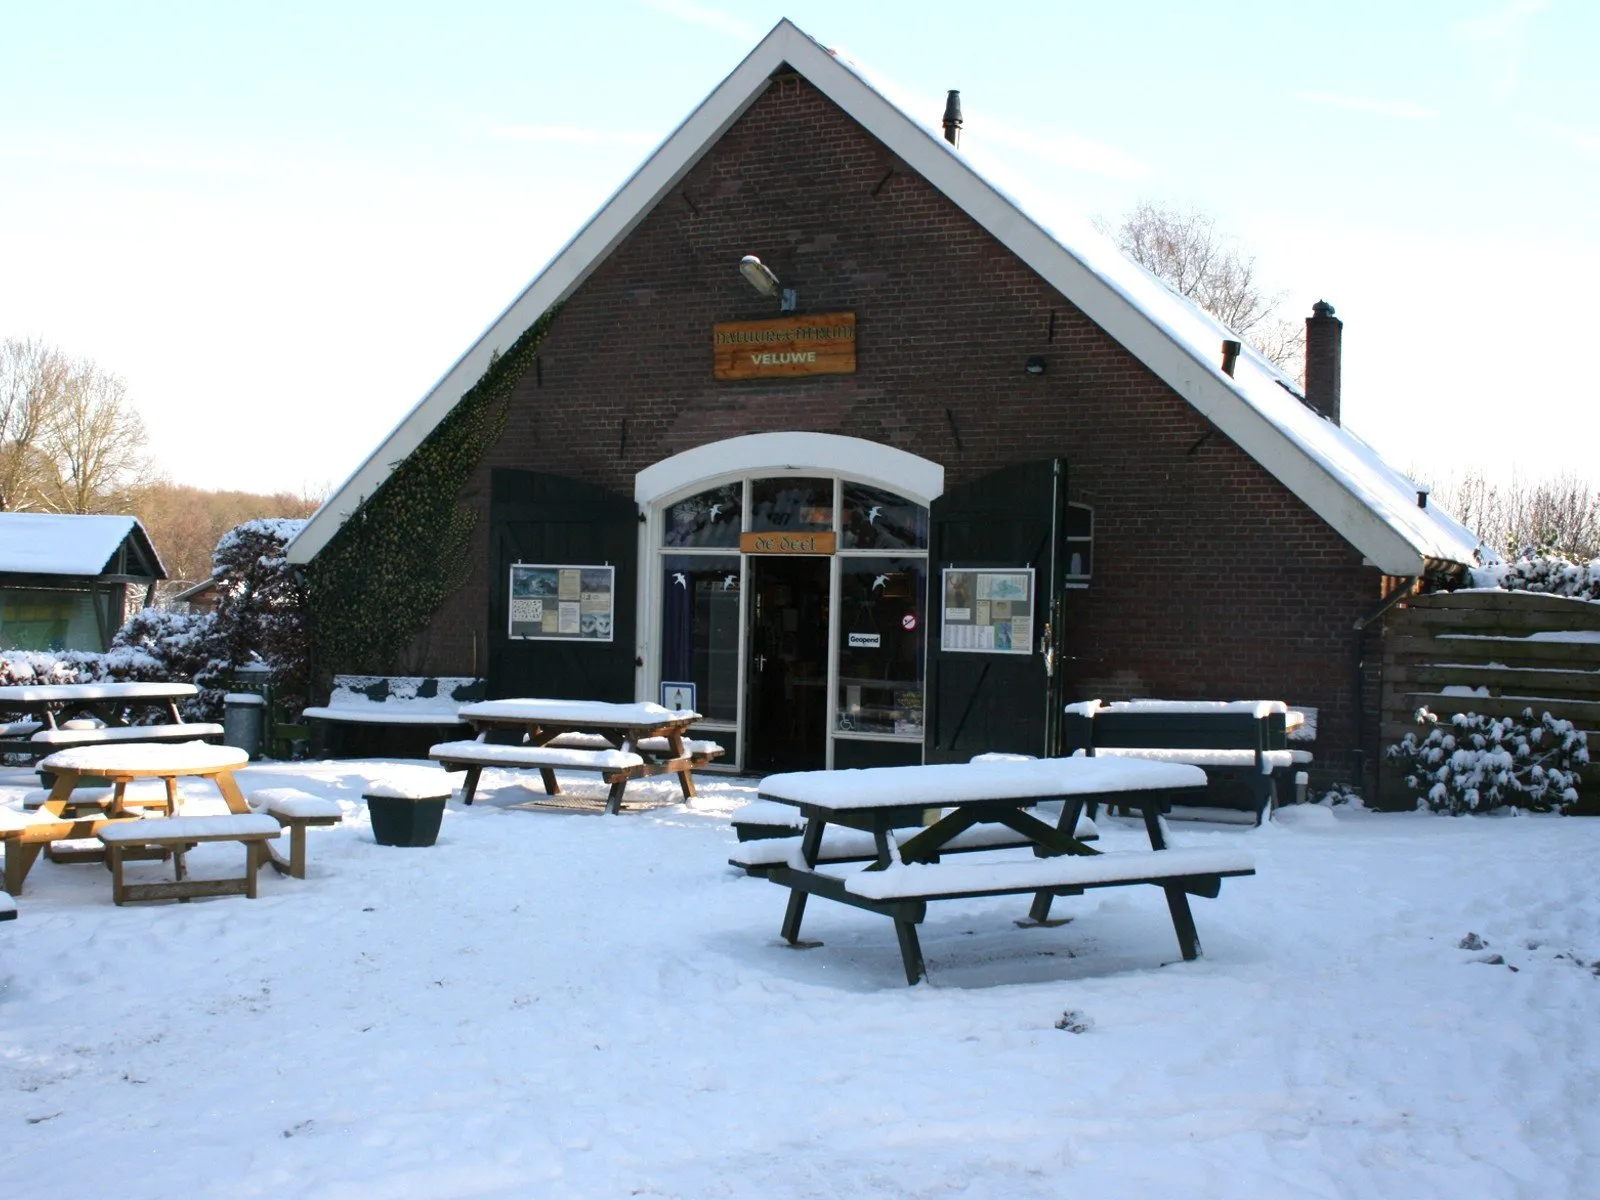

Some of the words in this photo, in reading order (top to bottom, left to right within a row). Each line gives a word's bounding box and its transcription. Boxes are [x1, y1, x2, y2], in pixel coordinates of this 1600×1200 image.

[751, 352, 817, 365] VELUWE
[780, 536, 816, 551] deel
[850, 636, 879, 644] Geopend
